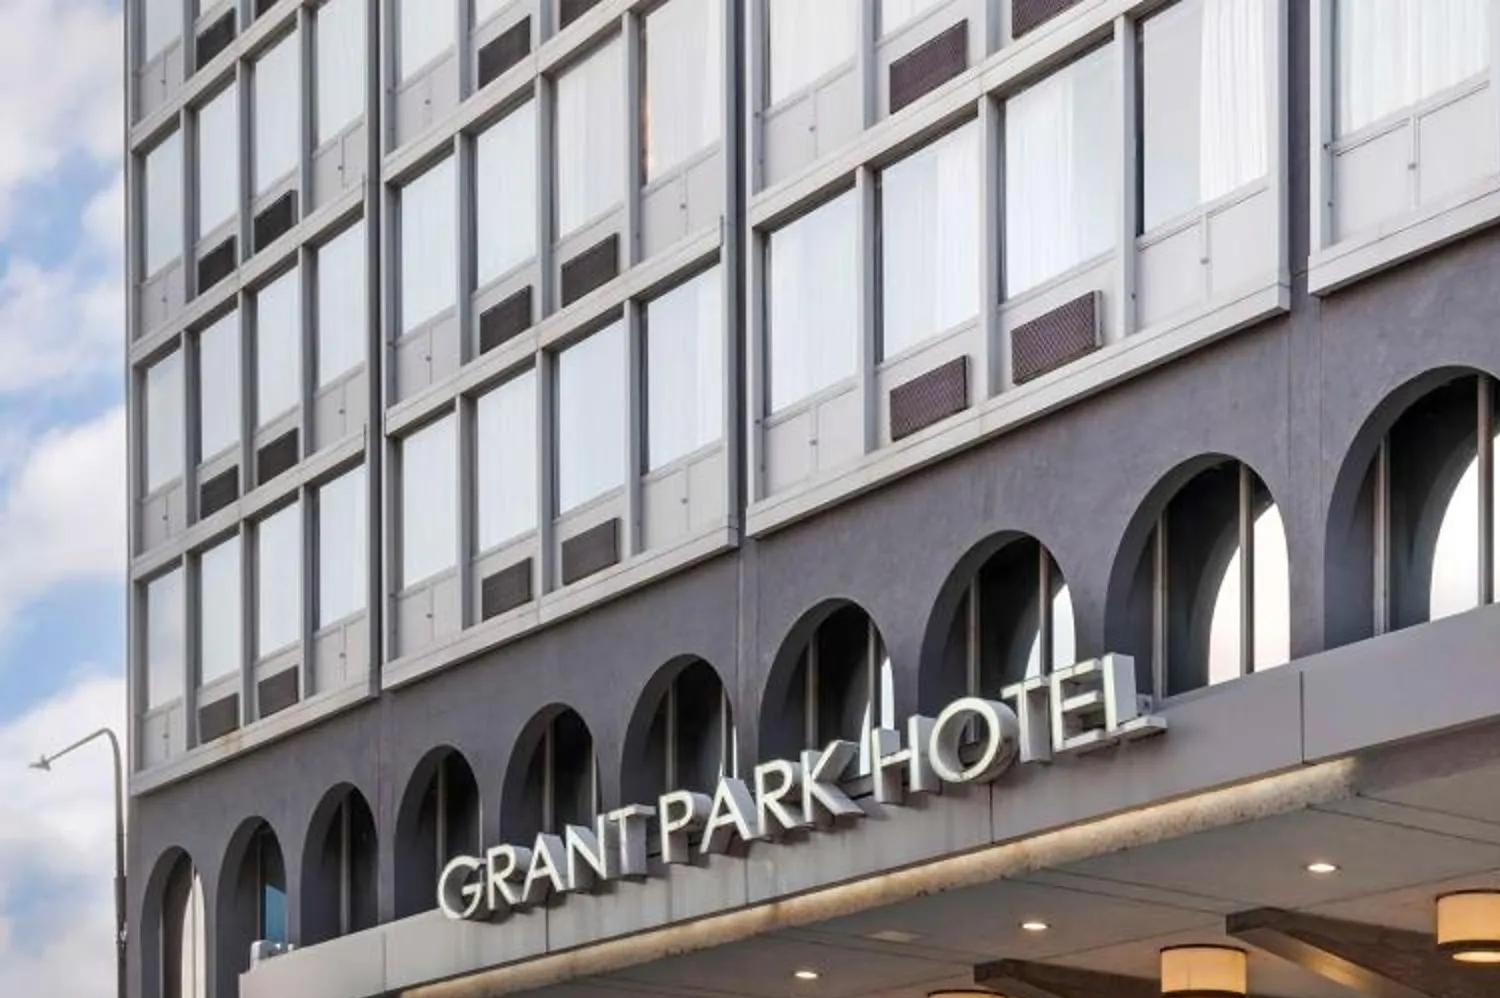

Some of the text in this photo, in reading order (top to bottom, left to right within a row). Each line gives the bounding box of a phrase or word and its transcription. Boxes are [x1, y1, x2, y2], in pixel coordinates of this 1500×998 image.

[437, 652, 1168, 919] GRANT PARK HOTEL
